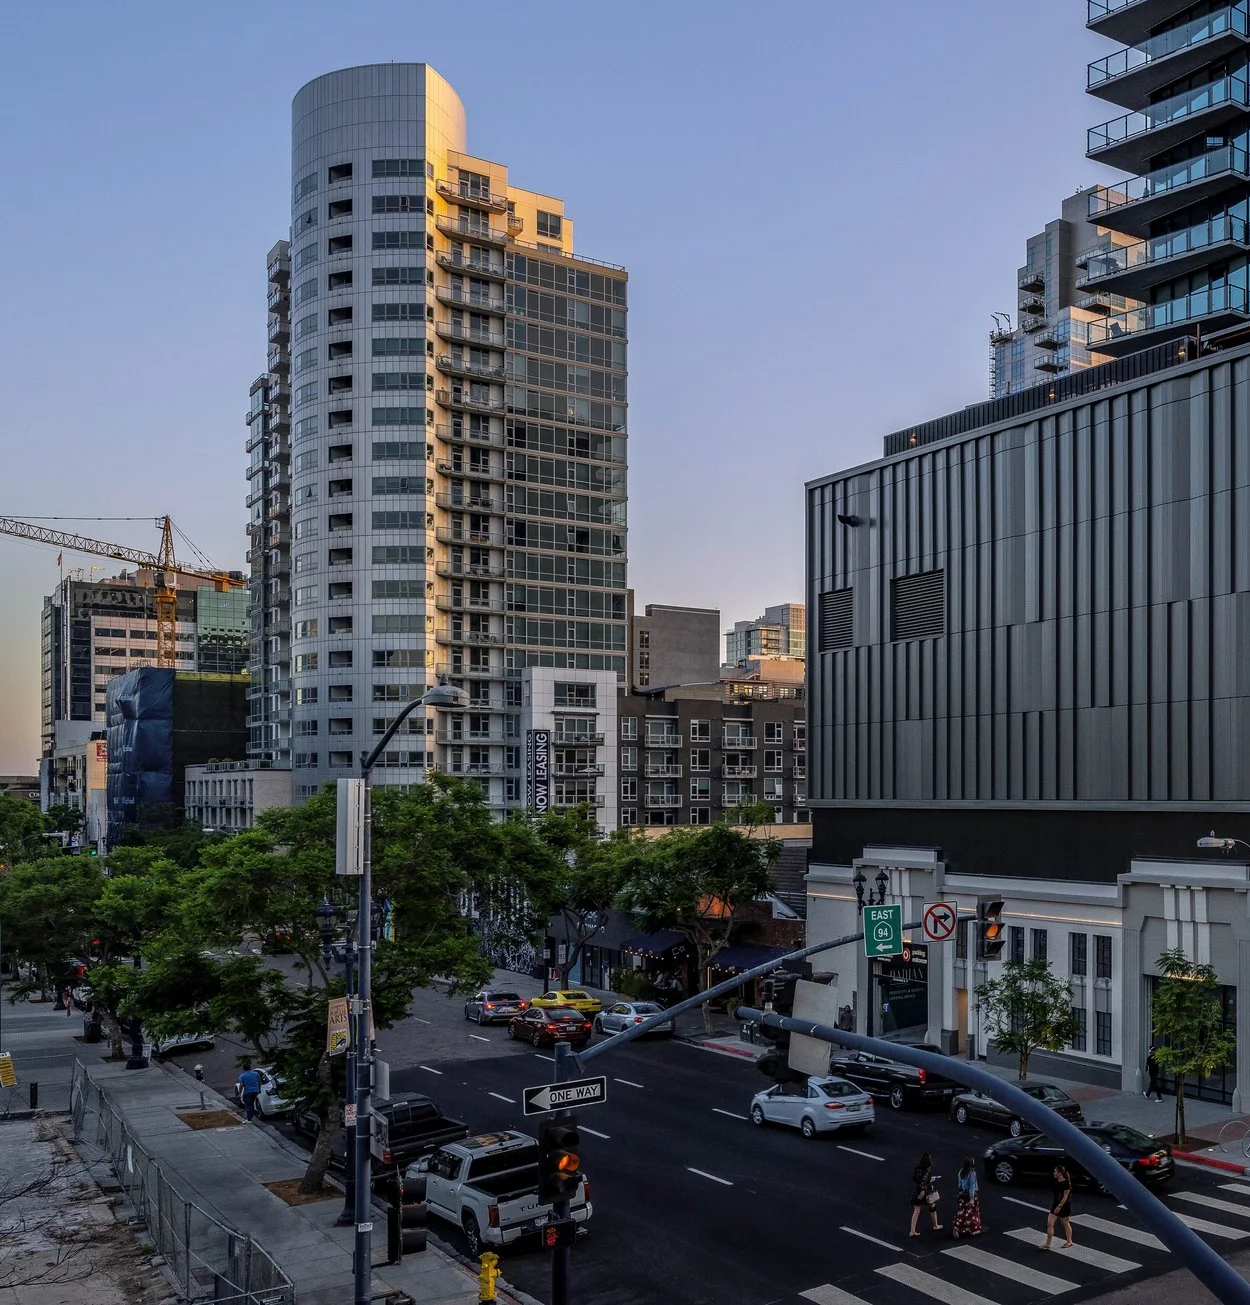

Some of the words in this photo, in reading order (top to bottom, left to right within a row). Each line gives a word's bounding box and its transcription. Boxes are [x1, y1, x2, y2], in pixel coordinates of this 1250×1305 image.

[535, 732, 548, 781] LEASING
[535, 784, 548, 814] NOW
[871, 909, 894, 921] EAST
[878, 927, 889, 938] 94
[329, 1014, 348, 1025] ARTS
[549, 1089, 572, 1103] ONE
[576, 1085, 598, 1098] WAY
